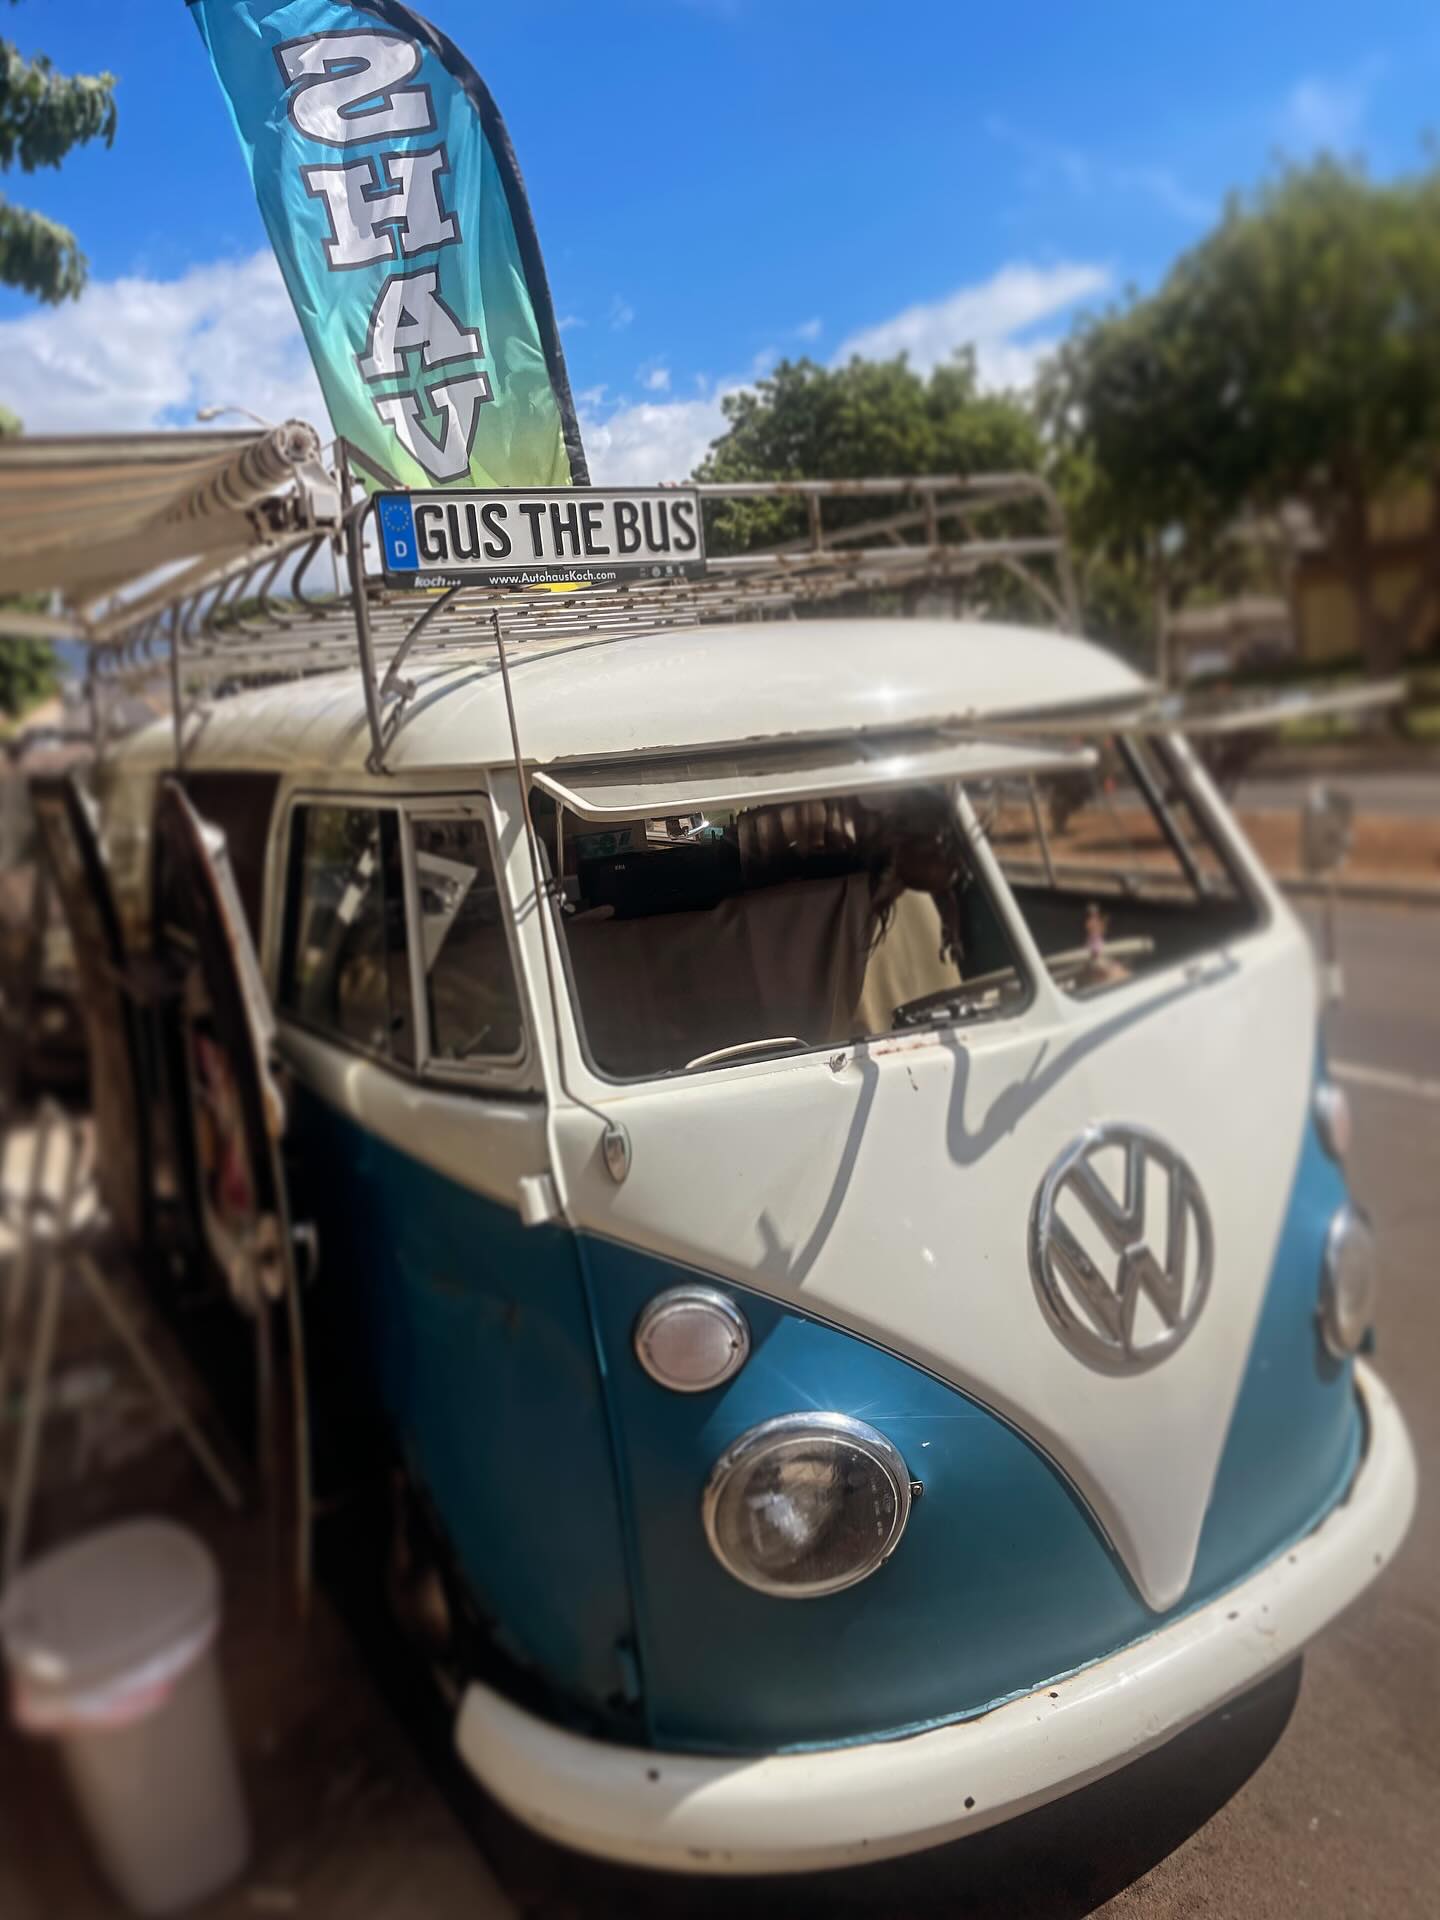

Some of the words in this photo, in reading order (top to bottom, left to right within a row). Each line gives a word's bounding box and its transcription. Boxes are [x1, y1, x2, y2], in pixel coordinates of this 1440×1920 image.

[394, 540, 408, 558] D
[414, 503, 512, 561] GUS
[519, 501, 610, 559] THE
[614, 500, 697, 554] BUS
[489, 569, 617, 584] www.AutohausKoch.com
[1044, 1134, 1196, 1355] VW
